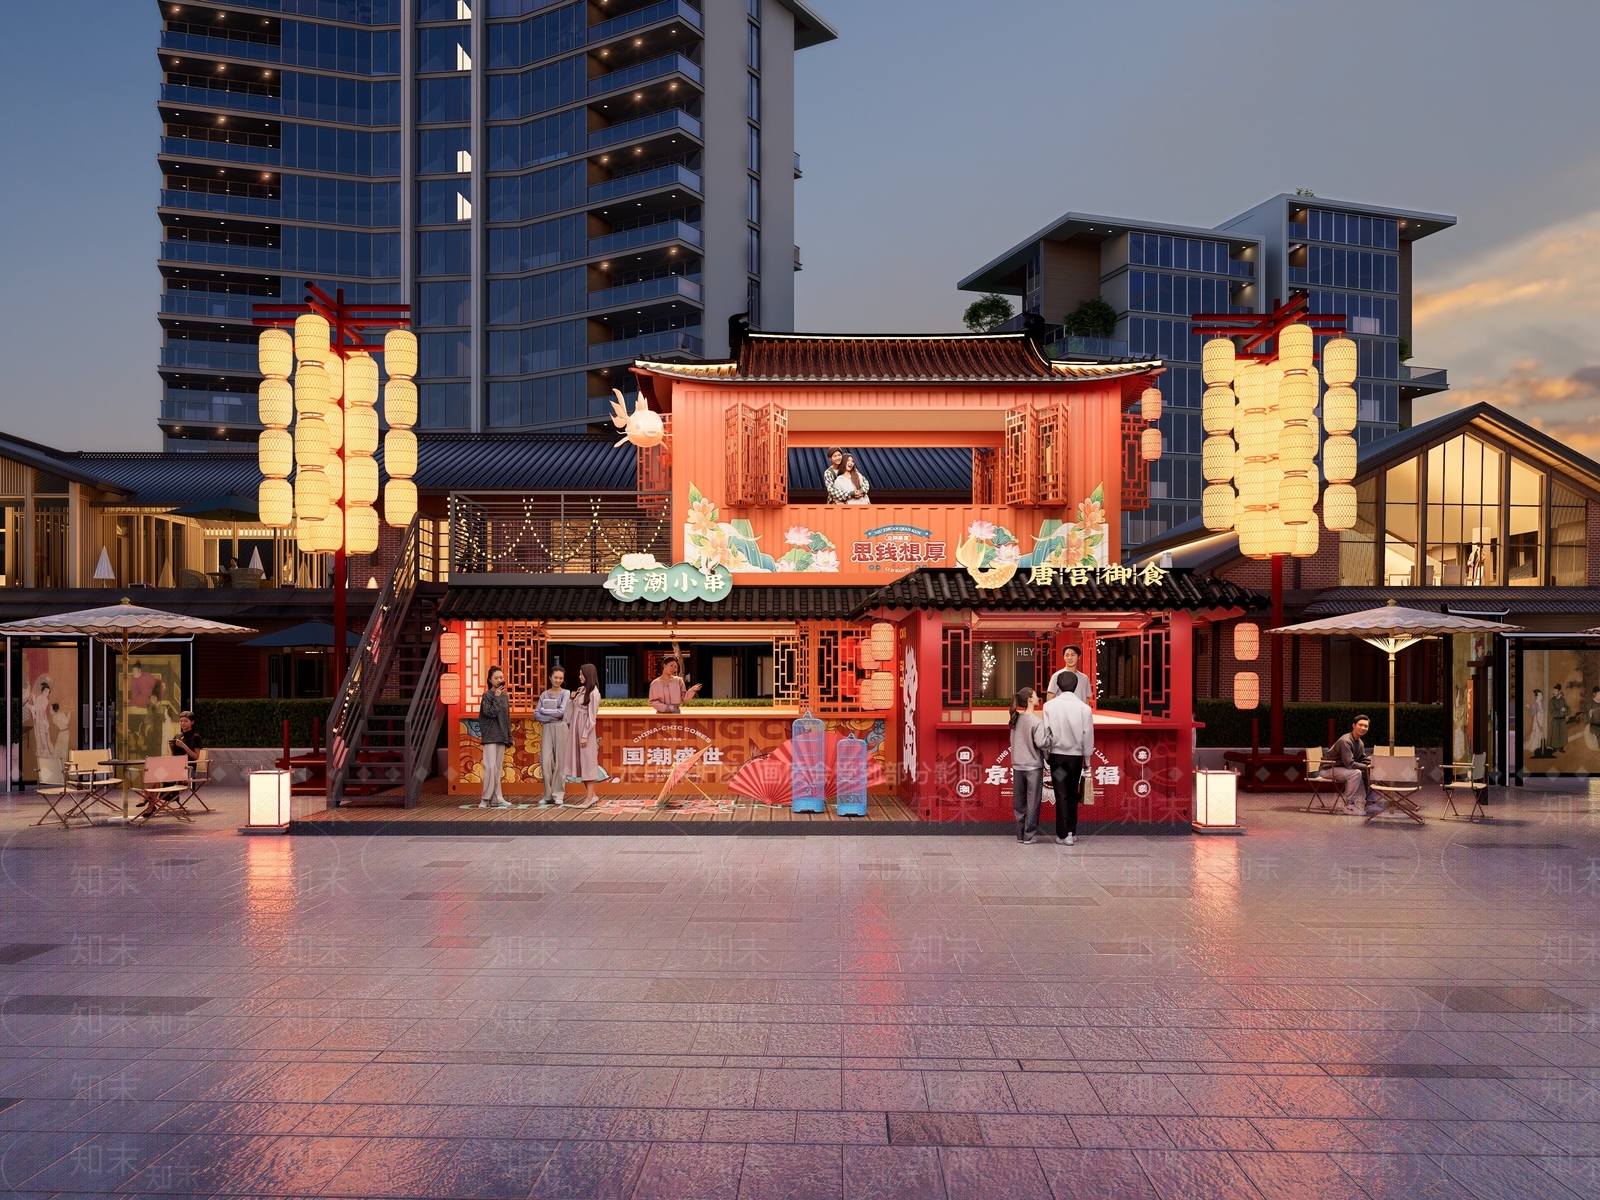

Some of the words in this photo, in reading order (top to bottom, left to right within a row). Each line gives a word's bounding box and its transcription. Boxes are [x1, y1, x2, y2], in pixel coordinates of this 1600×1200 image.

[851, 542, 946, 562] 思钱想厚
[615, 571, 726, 593] 唐潮小串
[1026, 561, 1170, 586] 唐宫御食
[684, 727, 712, 743] COMES
